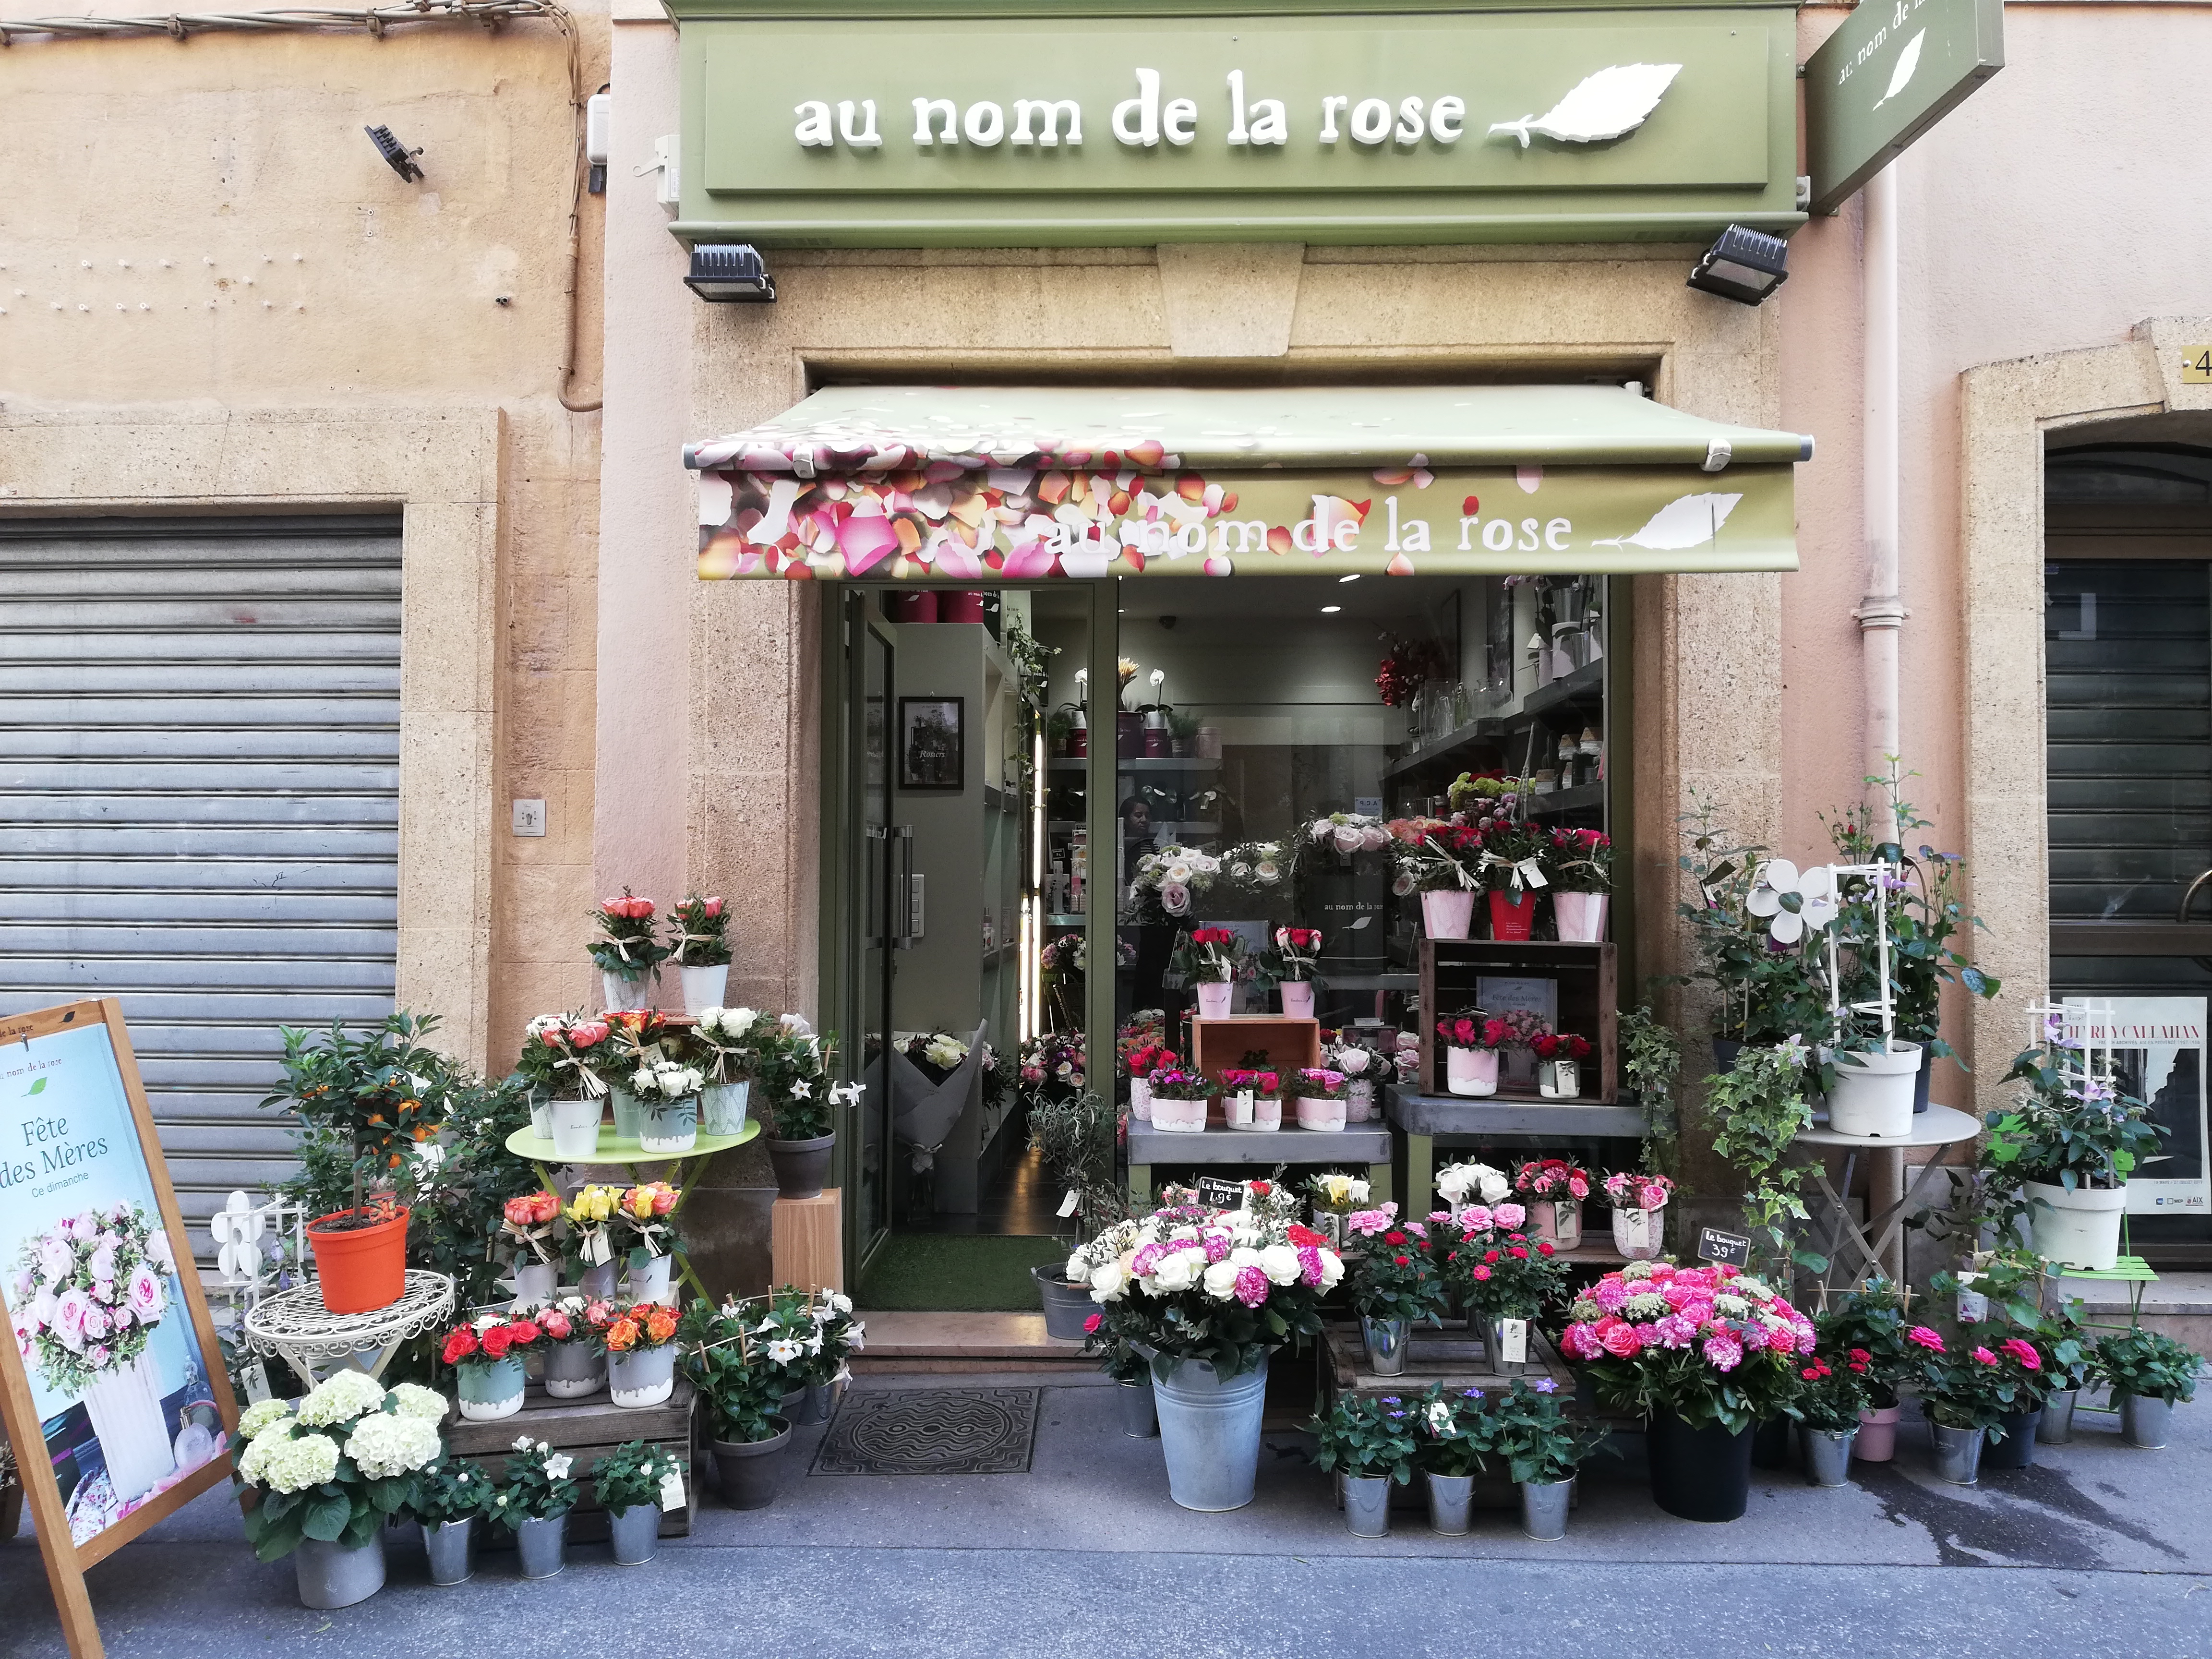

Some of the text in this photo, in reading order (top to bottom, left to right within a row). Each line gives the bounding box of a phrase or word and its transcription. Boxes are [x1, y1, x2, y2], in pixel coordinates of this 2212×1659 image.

[1858, 27, 1887, 65] nom
[1893, 0, 1909, 29] de
[794, 68, 1465, 146] au nom de la rose
[1044, 494, 1572, 554] au nom de la rose
[7, 1026, 16, 1035] la
[18, 1025, 34, 1033] rose
[7, 1068, 24, 1077] nom
[28, 1062, 36, 1071] de
[38, 1060, 46, 1069] la
[48, 1058, 62, 1067] rose
[21, 1117, 69, 1147] Fête
[0, 1138, 108, 1189] des Mères
[32, 1172, 89, 1198] Ce dimanche
[1202, 1180, 1242, 1195] Le bouquet
[1706, 1230, 1746, 1248] Le bouquet
